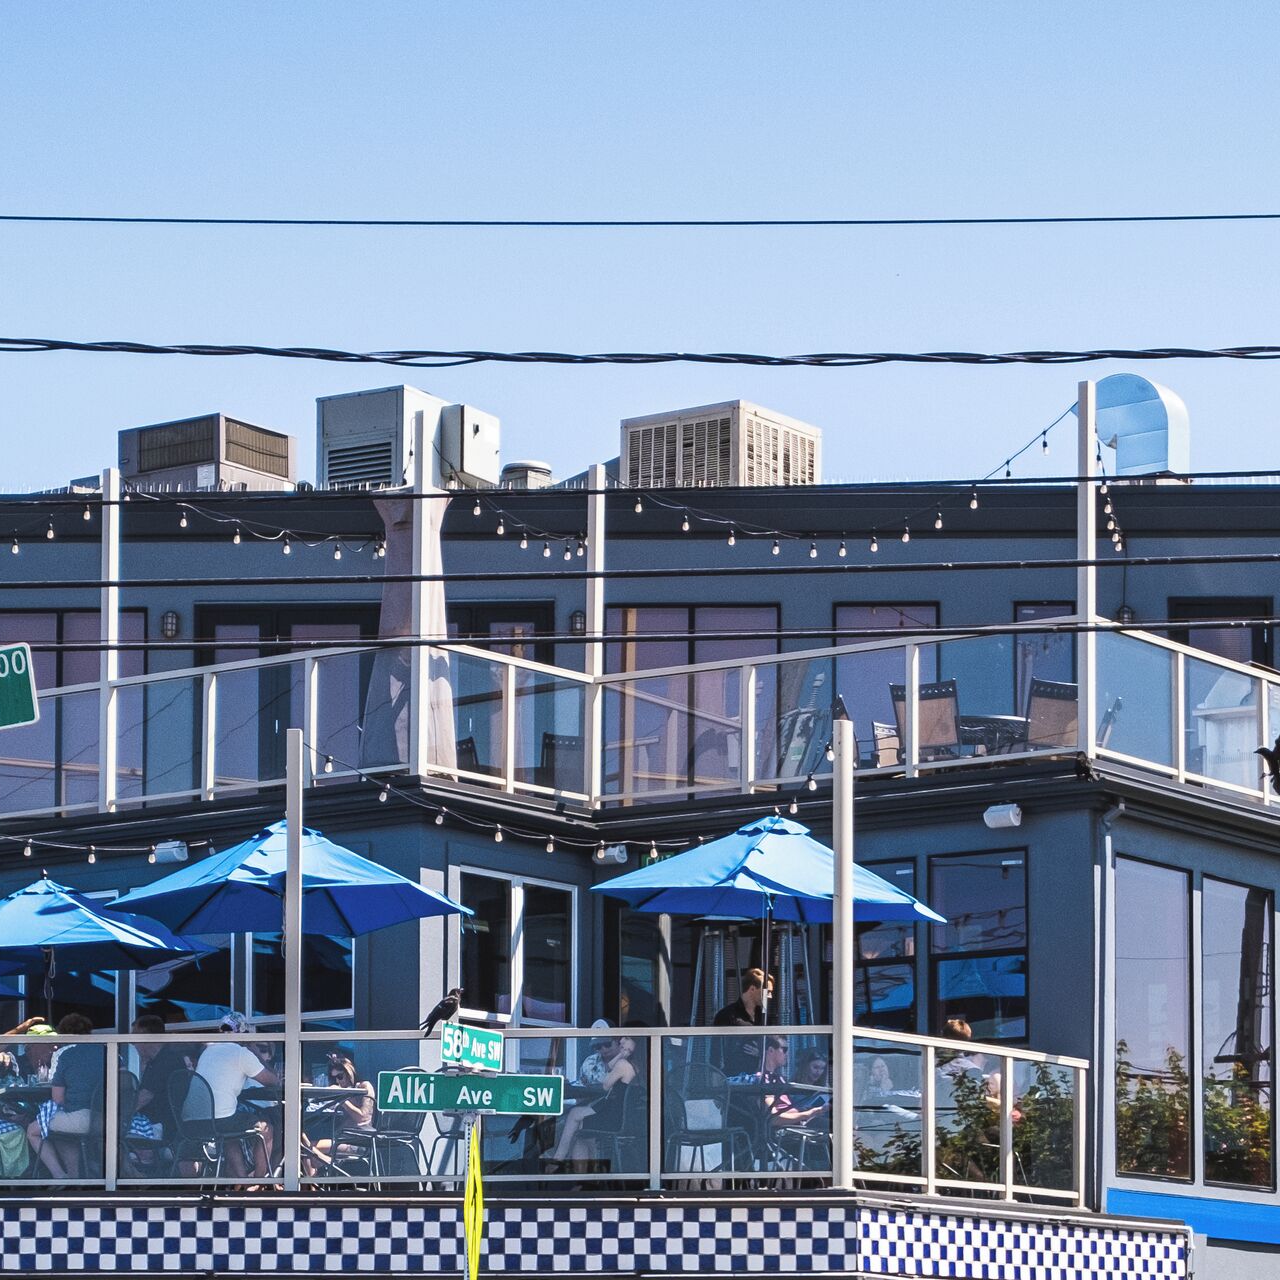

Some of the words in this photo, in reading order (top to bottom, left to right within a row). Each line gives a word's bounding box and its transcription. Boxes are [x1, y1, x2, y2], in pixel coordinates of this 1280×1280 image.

[443, 1027, 470, 1058] 58th
[471, 1037, 487, 1059] Ave
[488, 1040, 501, 1062] SW
[387, 1075, 435, 1104] Alki
[456, 1085, 493, 1105] Ave
[523, 1087, 554, 1107] SW
